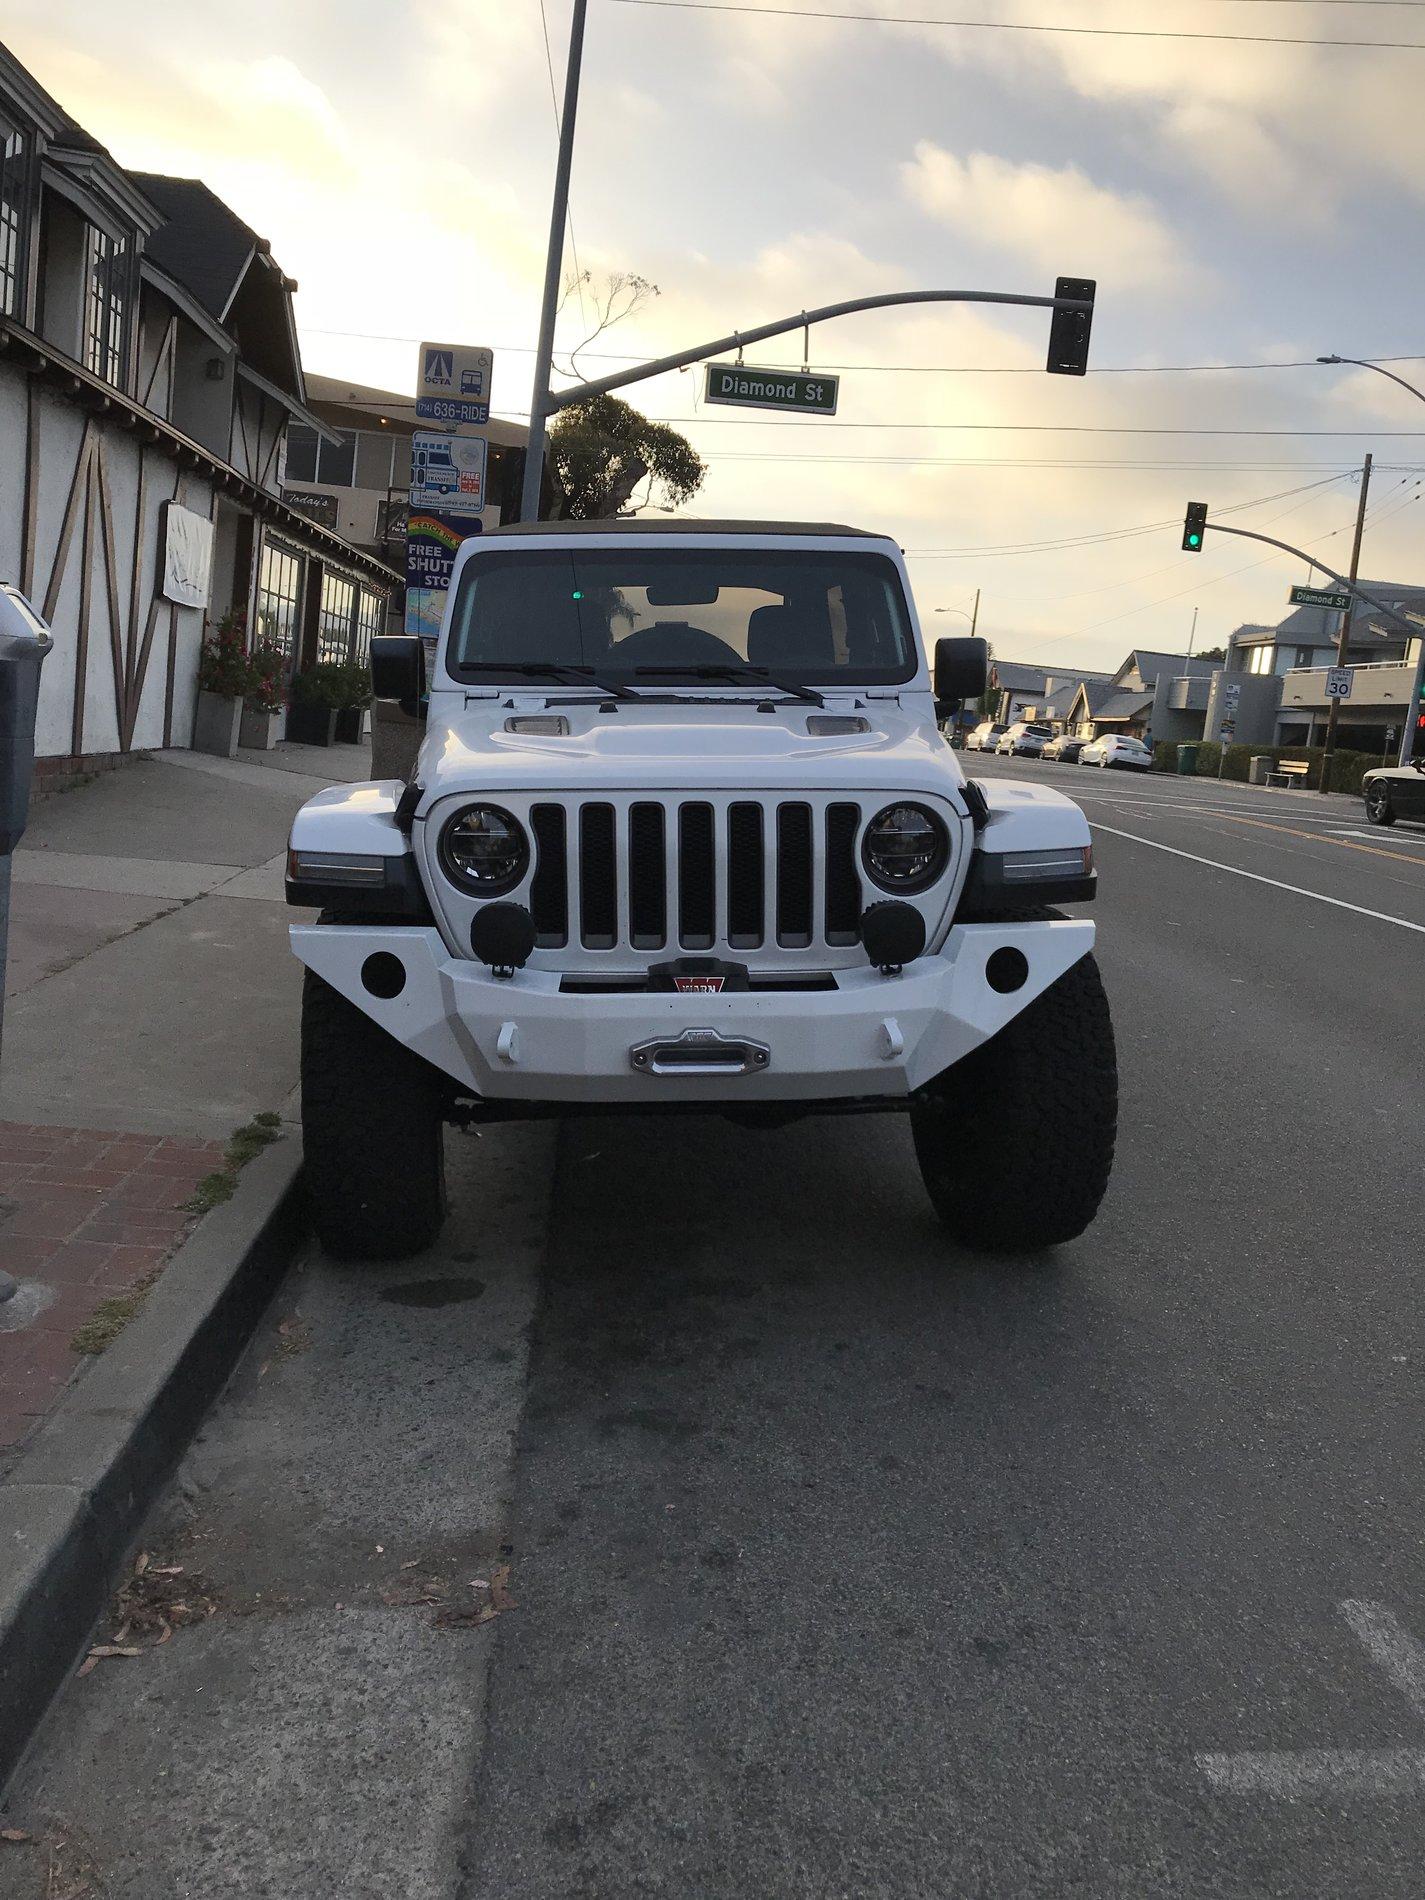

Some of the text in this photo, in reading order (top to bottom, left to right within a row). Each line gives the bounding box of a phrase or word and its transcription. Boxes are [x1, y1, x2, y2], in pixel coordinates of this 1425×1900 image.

[424, 376, 451, 386] OCTA
[721, 375, 823, 401] Diamond St
[433, 401, 487, 421] 636-RIDE
[462, 472, 480, 480] FREE
[287, 493, 328, 507] Today's
[408, 544, 442, 557] FREE
[1297, 591, 1346, 606] Diamond St
[1329, 682, 1349, 695] 30
